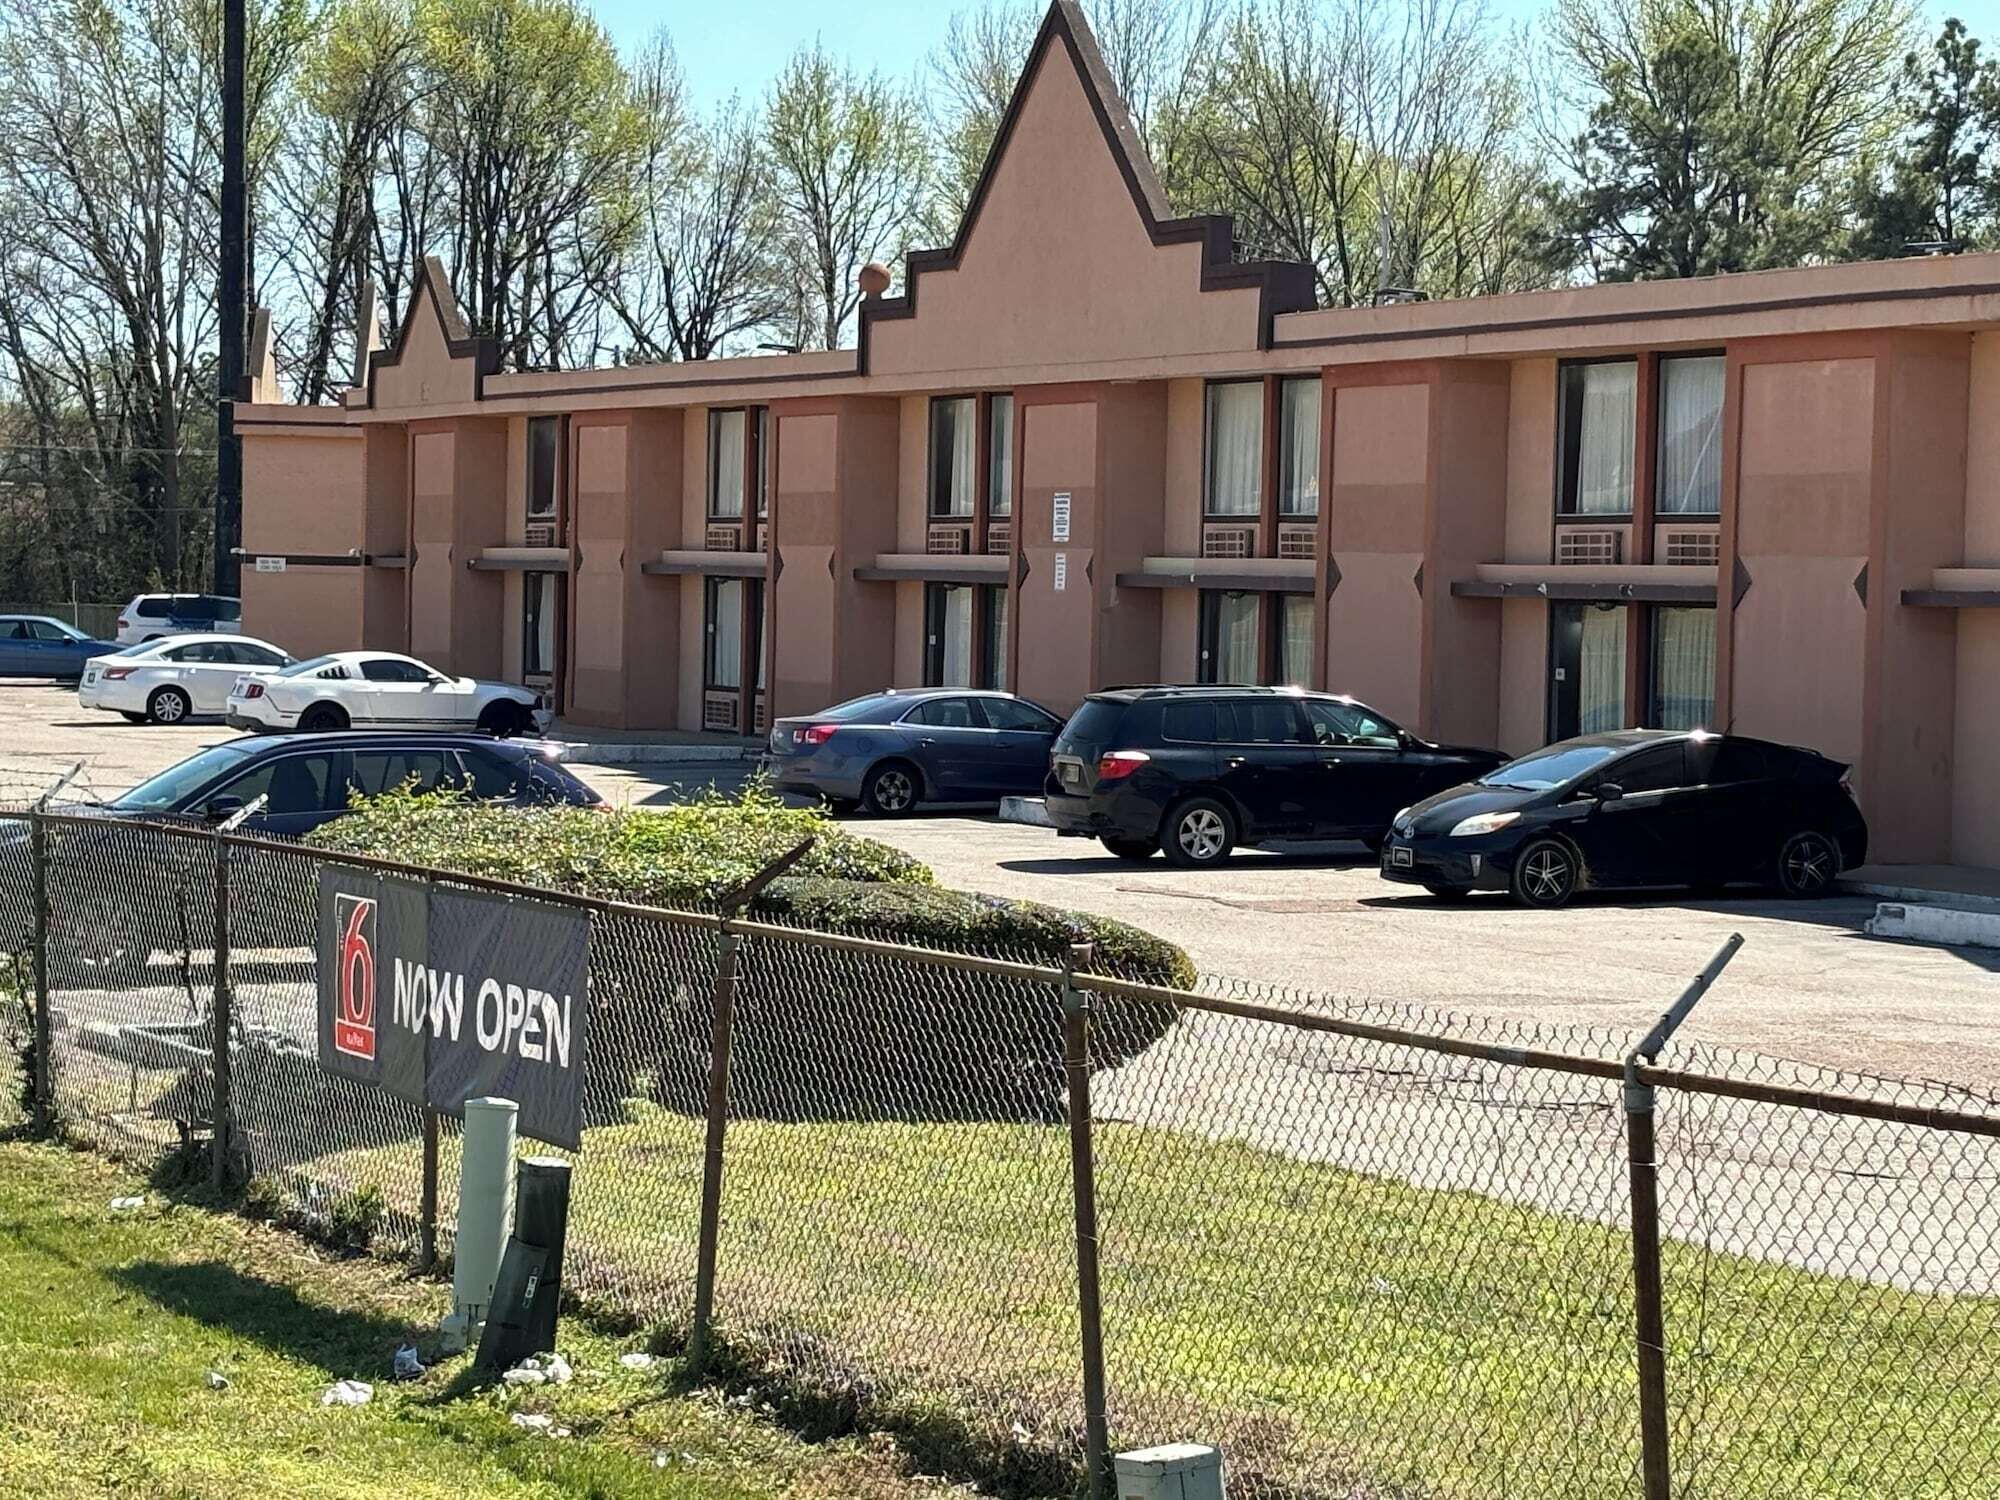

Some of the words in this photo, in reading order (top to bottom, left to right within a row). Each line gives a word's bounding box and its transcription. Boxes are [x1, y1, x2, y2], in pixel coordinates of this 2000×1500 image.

[344, 900, 373, 1027] 6
[394, 958, 464, 1041] NOW
[476, 978, 571, 1068] OPEN
